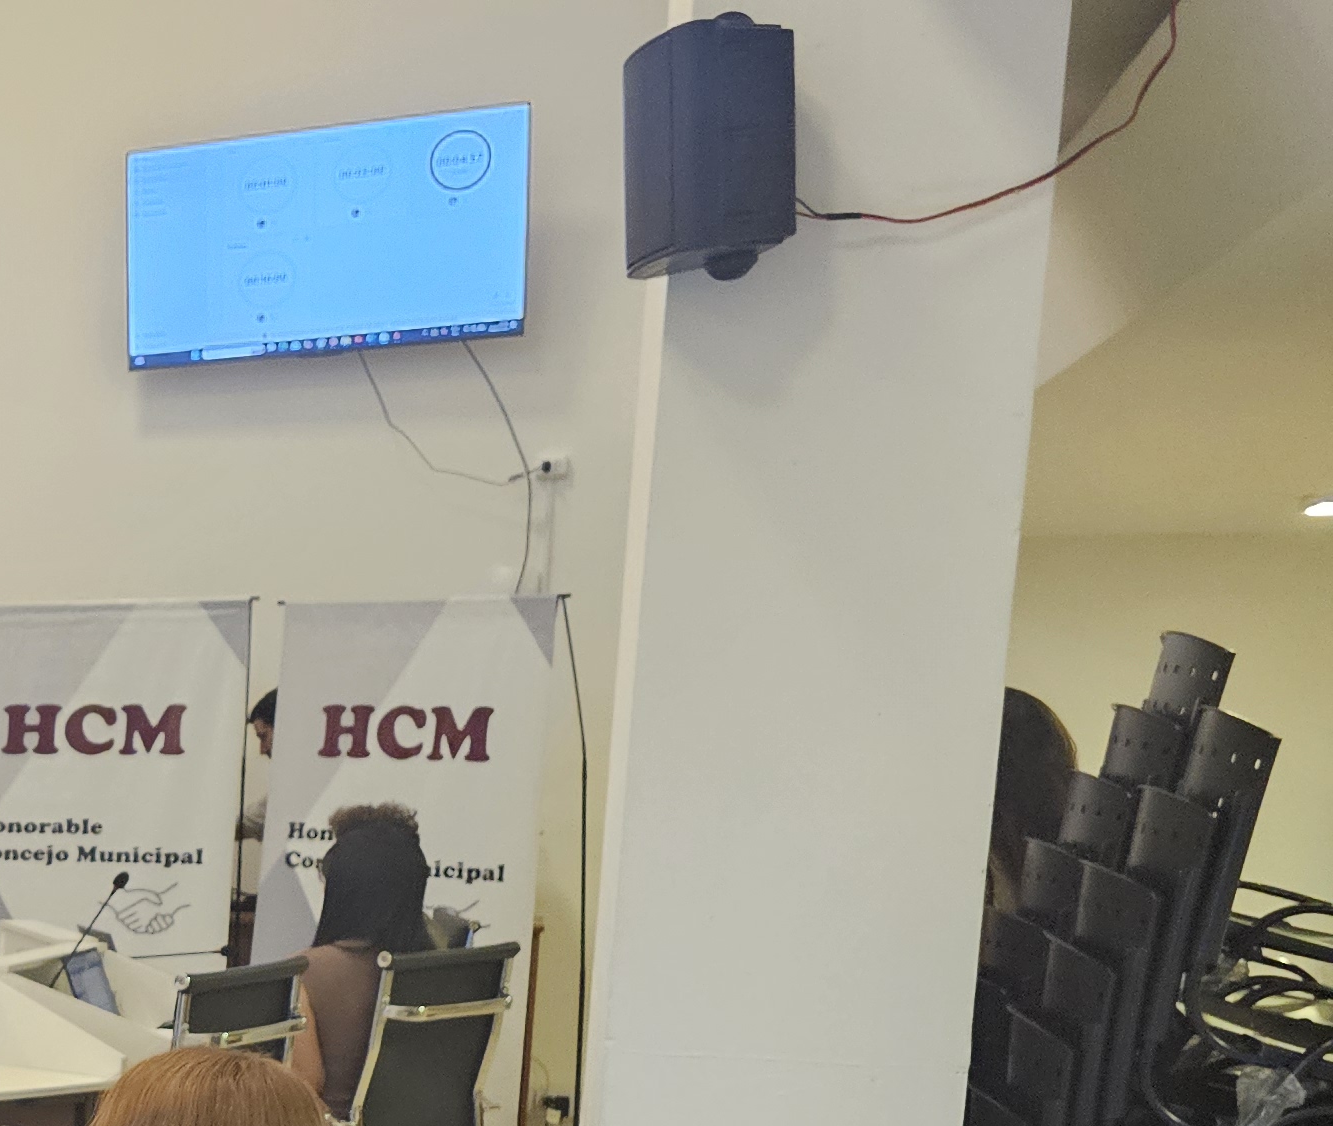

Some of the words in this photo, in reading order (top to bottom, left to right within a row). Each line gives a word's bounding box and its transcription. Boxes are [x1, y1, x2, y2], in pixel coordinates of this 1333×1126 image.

[0, 704, 187, 755] HCM
[318, 704, 494, 762] HCM
[76, 846, 203, 869] Municipal
[428, 859, 505, 884] icipal
